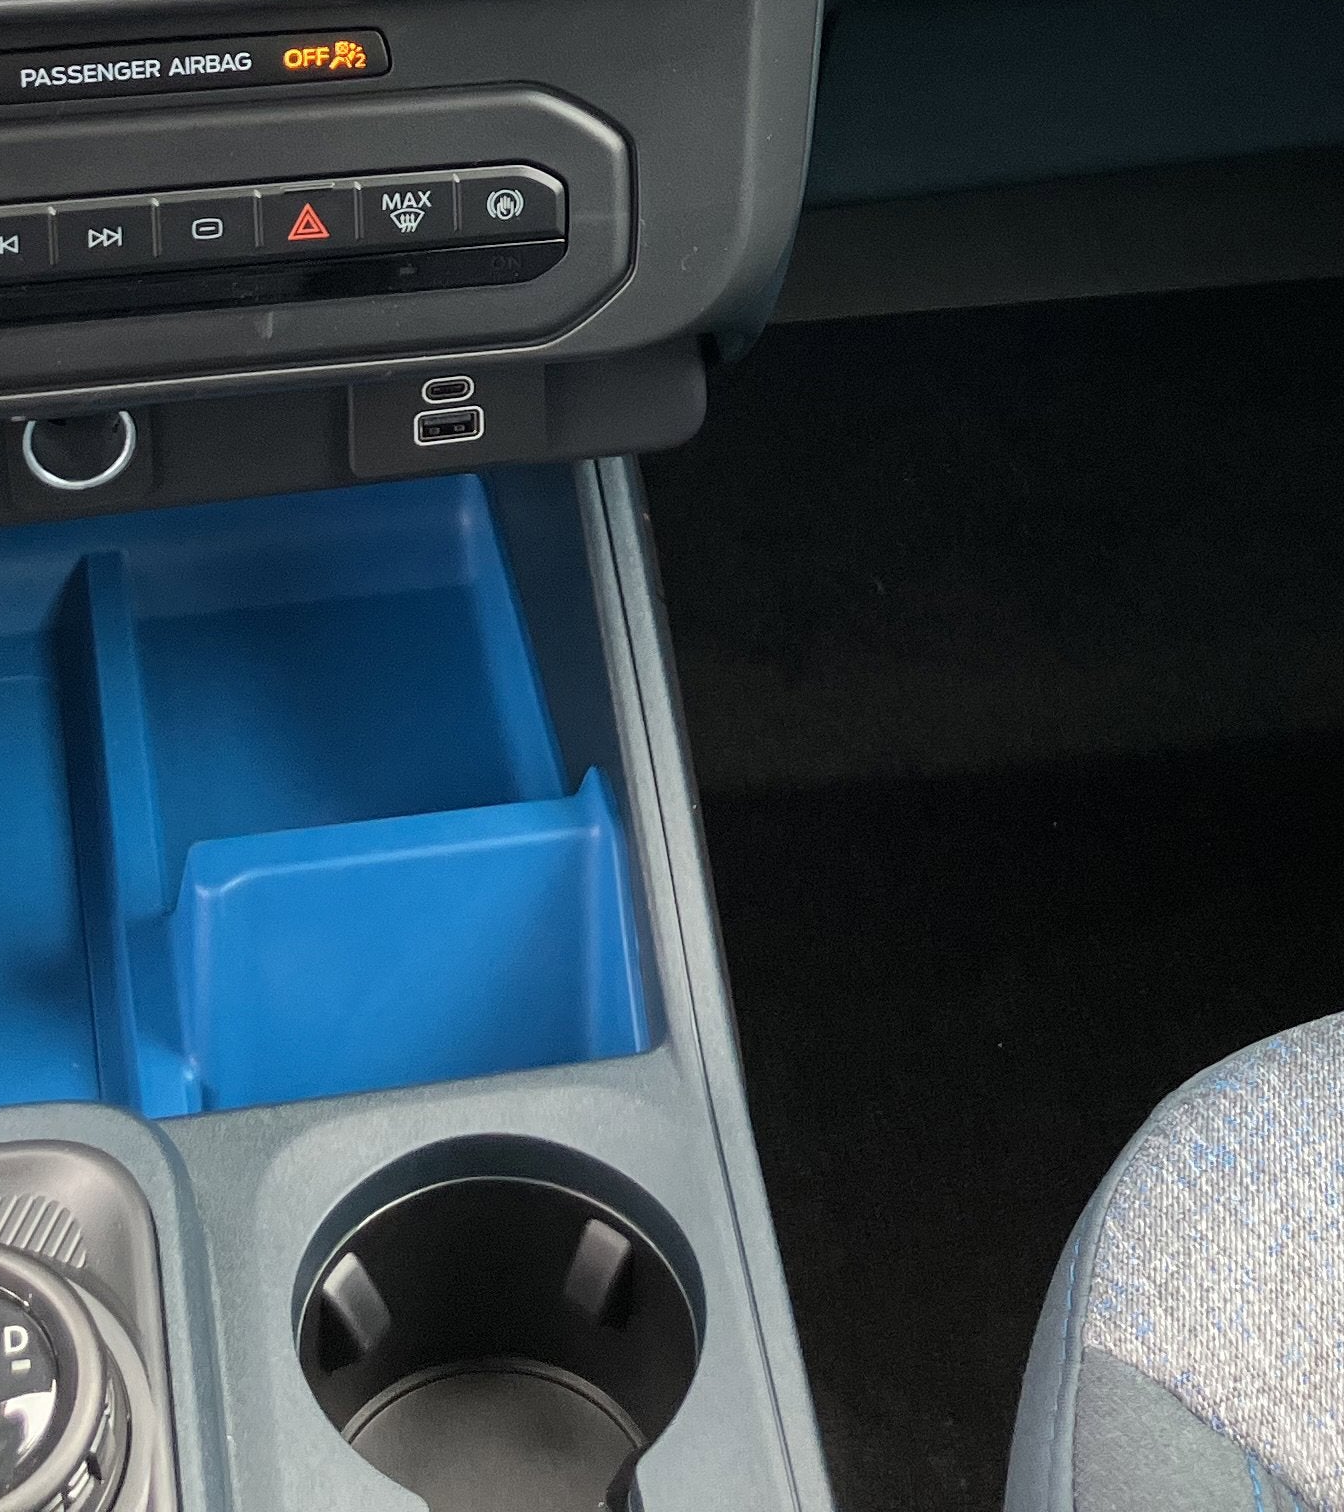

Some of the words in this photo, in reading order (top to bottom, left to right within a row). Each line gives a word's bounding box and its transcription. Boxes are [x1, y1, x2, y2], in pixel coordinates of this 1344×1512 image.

[20, 59, 161, 89] PASSENGER
[168, 51, 253, 76] AIRBAG
[282, 45, 330, 69] OFF
[381, 190, 432, 211] MAX
[2, 1324, 30, 1354] D
